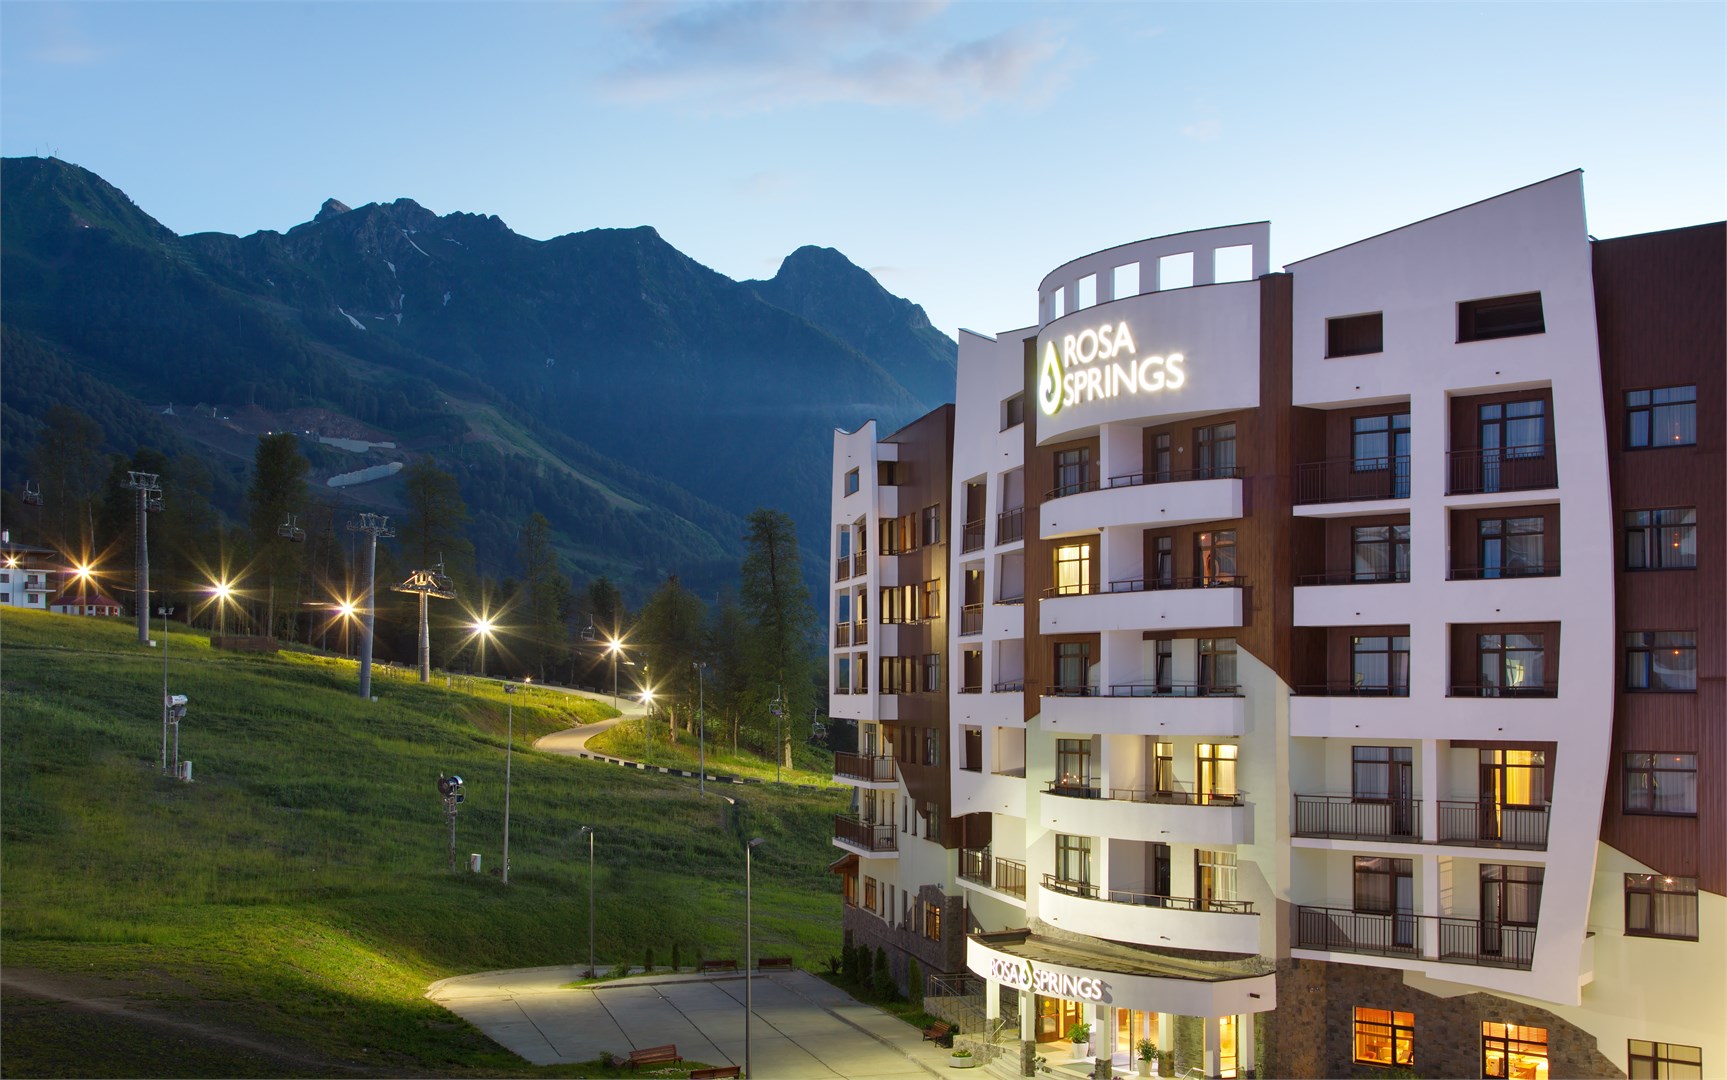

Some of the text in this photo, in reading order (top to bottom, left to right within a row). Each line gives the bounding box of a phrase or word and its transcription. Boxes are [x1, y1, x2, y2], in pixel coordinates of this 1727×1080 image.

[1064, 321, 1136, 367] ROSA
[1063, 353, 1185, 406] SPRINGS
[990, 957, 1102, 1000] ROSA SPRINGS
